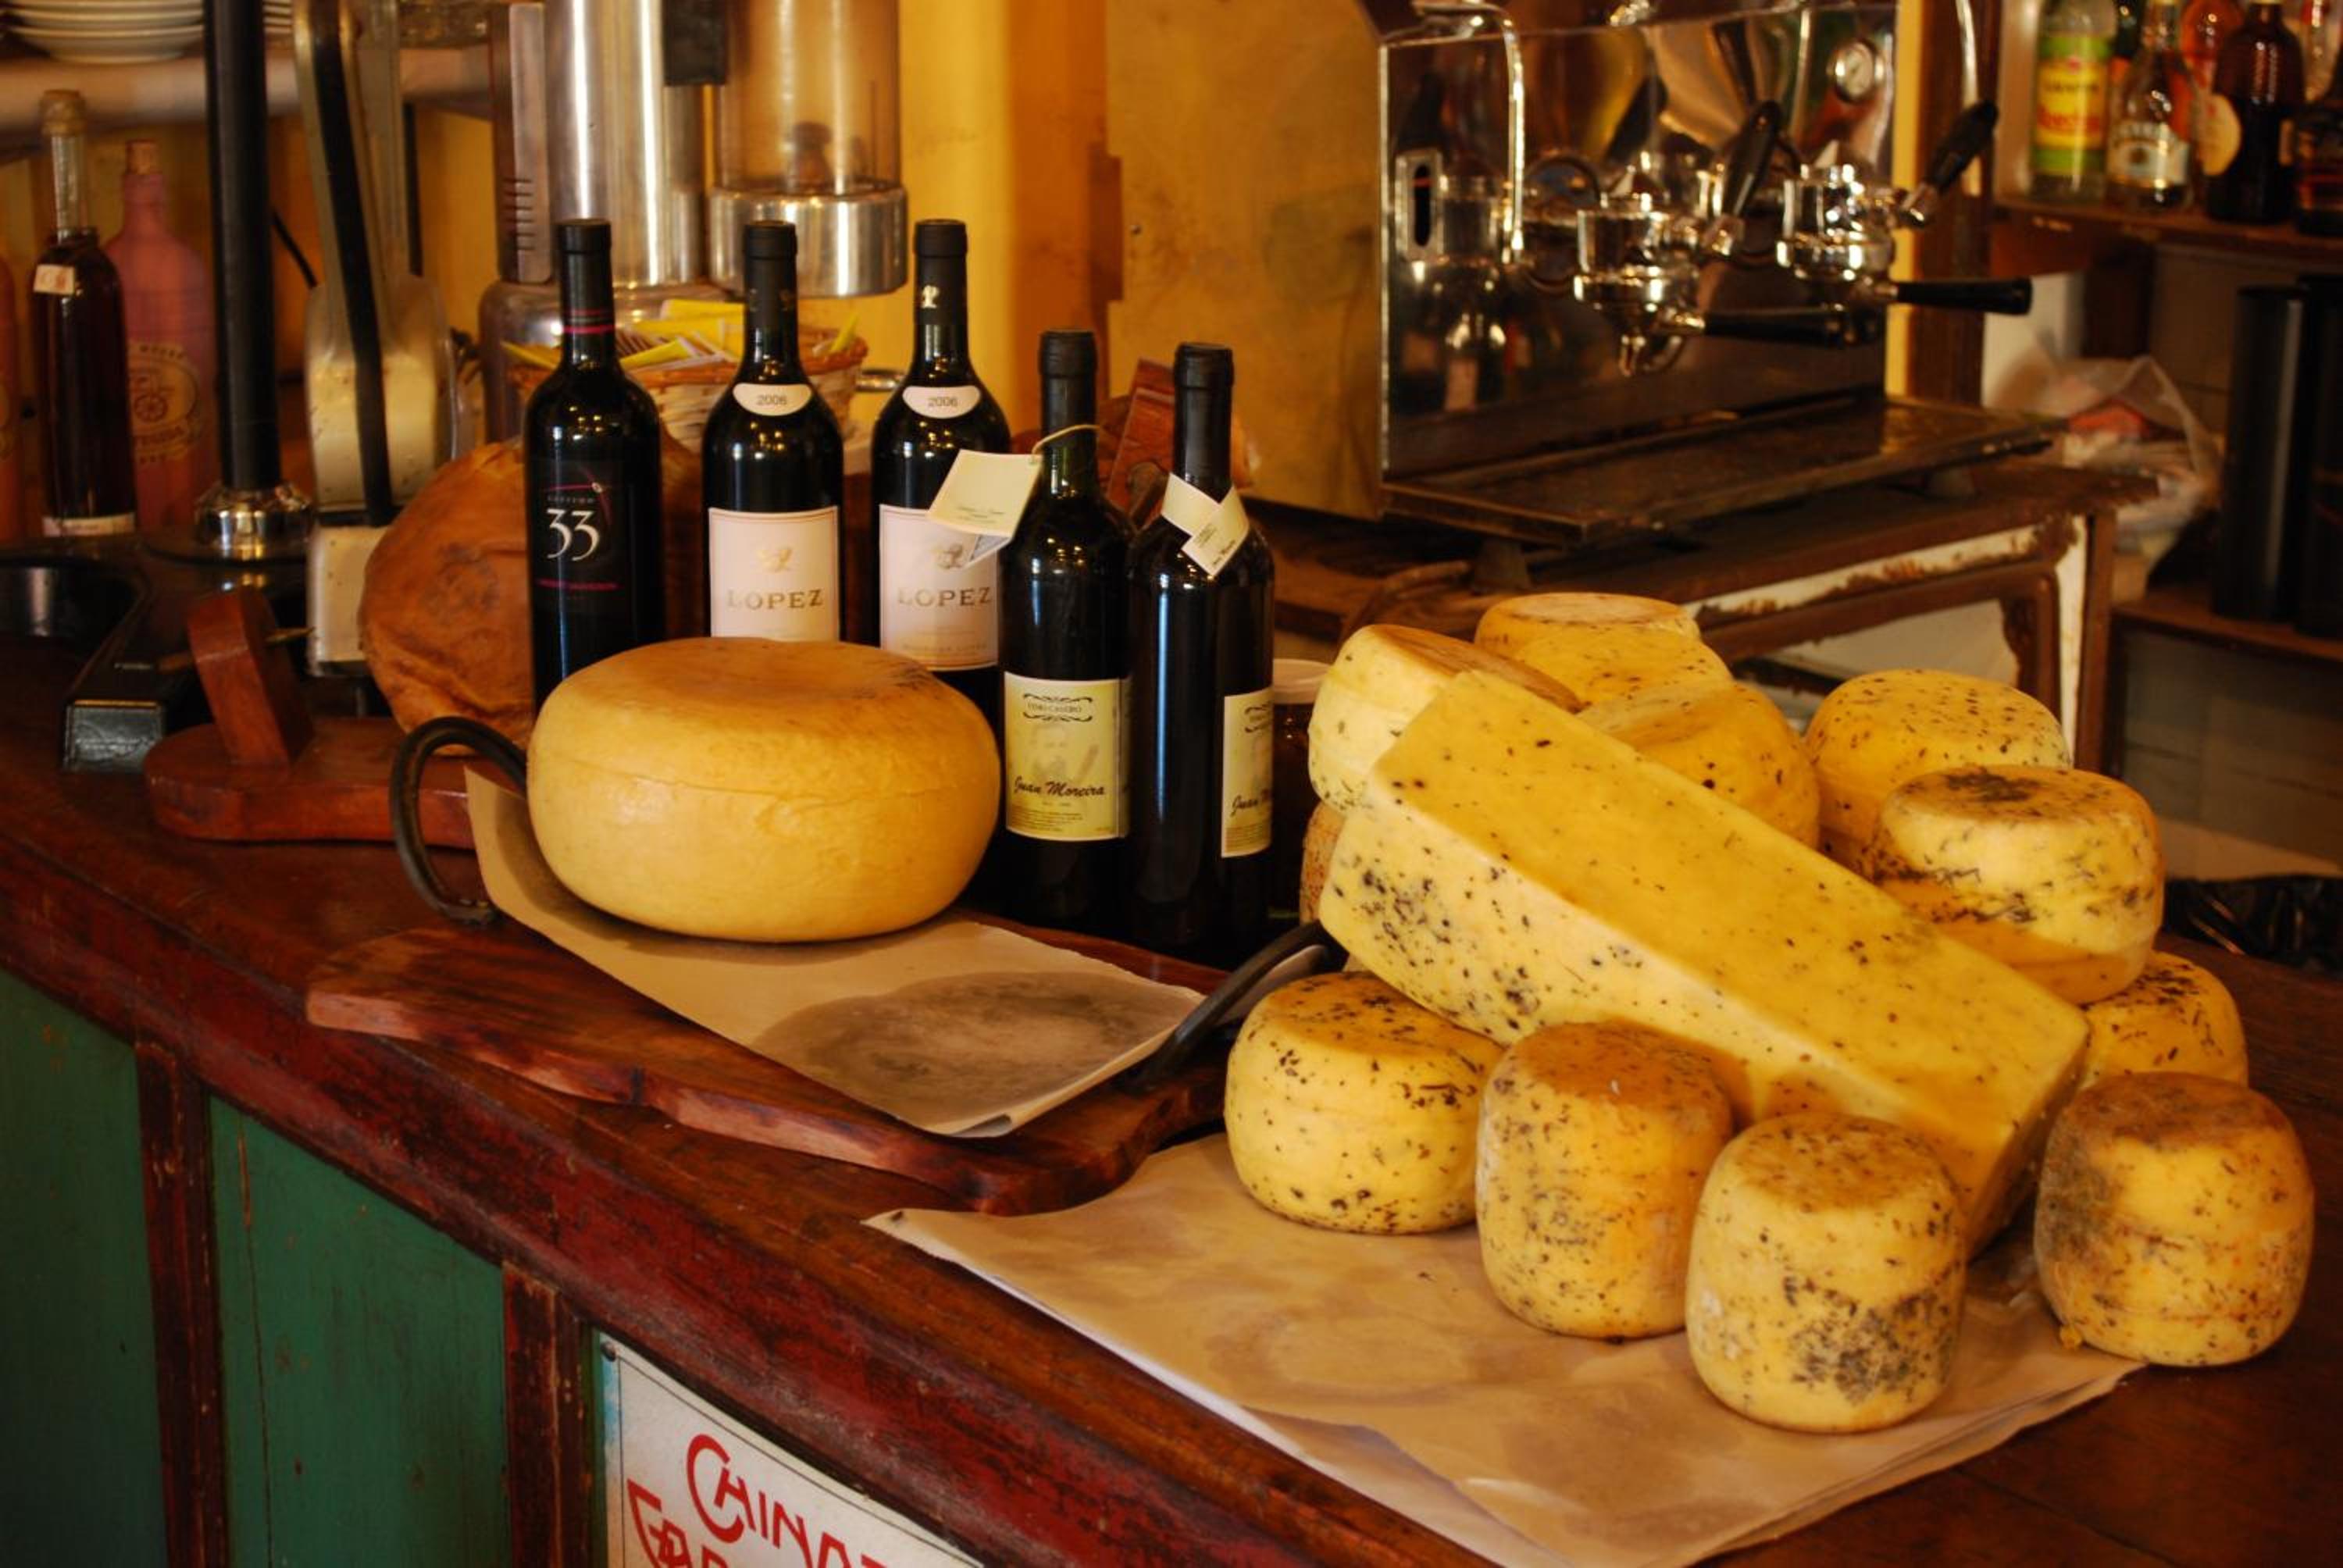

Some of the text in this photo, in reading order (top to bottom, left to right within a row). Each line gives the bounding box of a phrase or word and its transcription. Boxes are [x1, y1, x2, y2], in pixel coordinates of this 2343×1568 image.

[755, 394, 788, 405] 2006
[927, 396, 958, 407] 2006
[547, 508, 600, 561] 33
[726, 589, 824, 611] LOPEZ
[898, 586, 993, 608] LOPEZ
[1014, 775, 1106, 797] Juan Moreira
